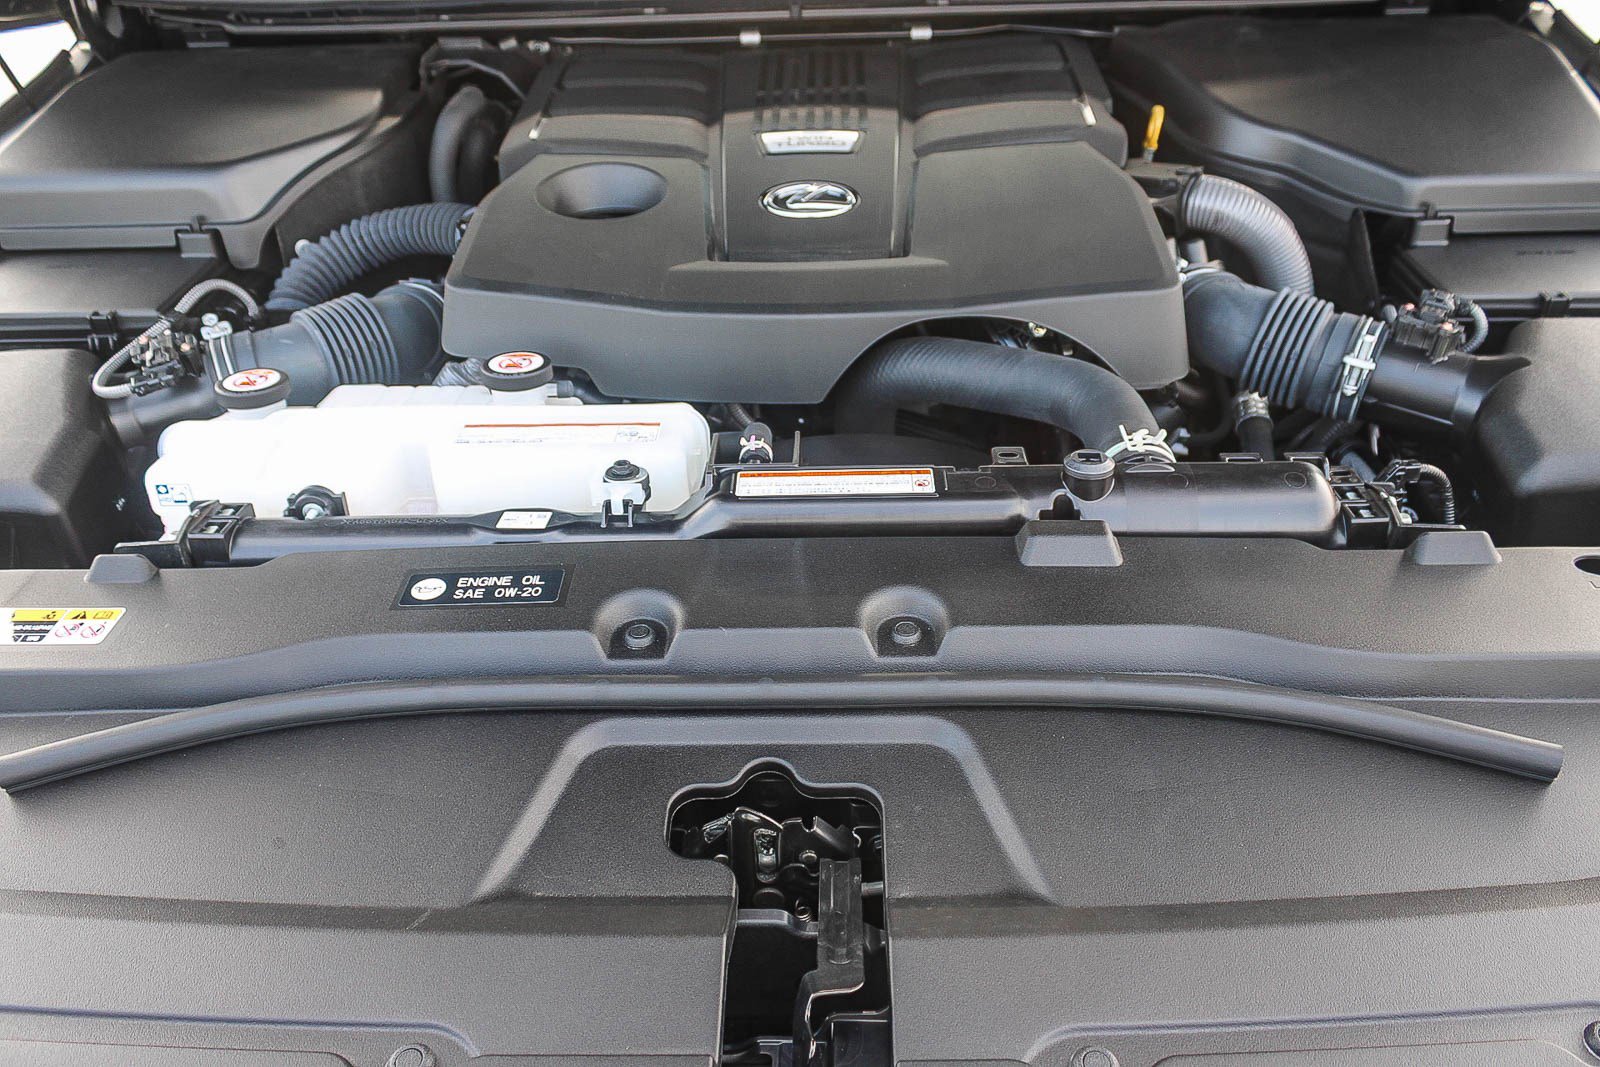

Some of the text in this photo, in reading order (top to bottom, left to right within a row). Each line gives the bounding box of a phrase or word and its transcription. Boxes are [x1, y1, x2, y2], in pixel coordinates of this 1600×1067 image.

[456, 575, 545, 588] ENGINE OIL
[453, 587, 543, 599] SAE 0W-20
